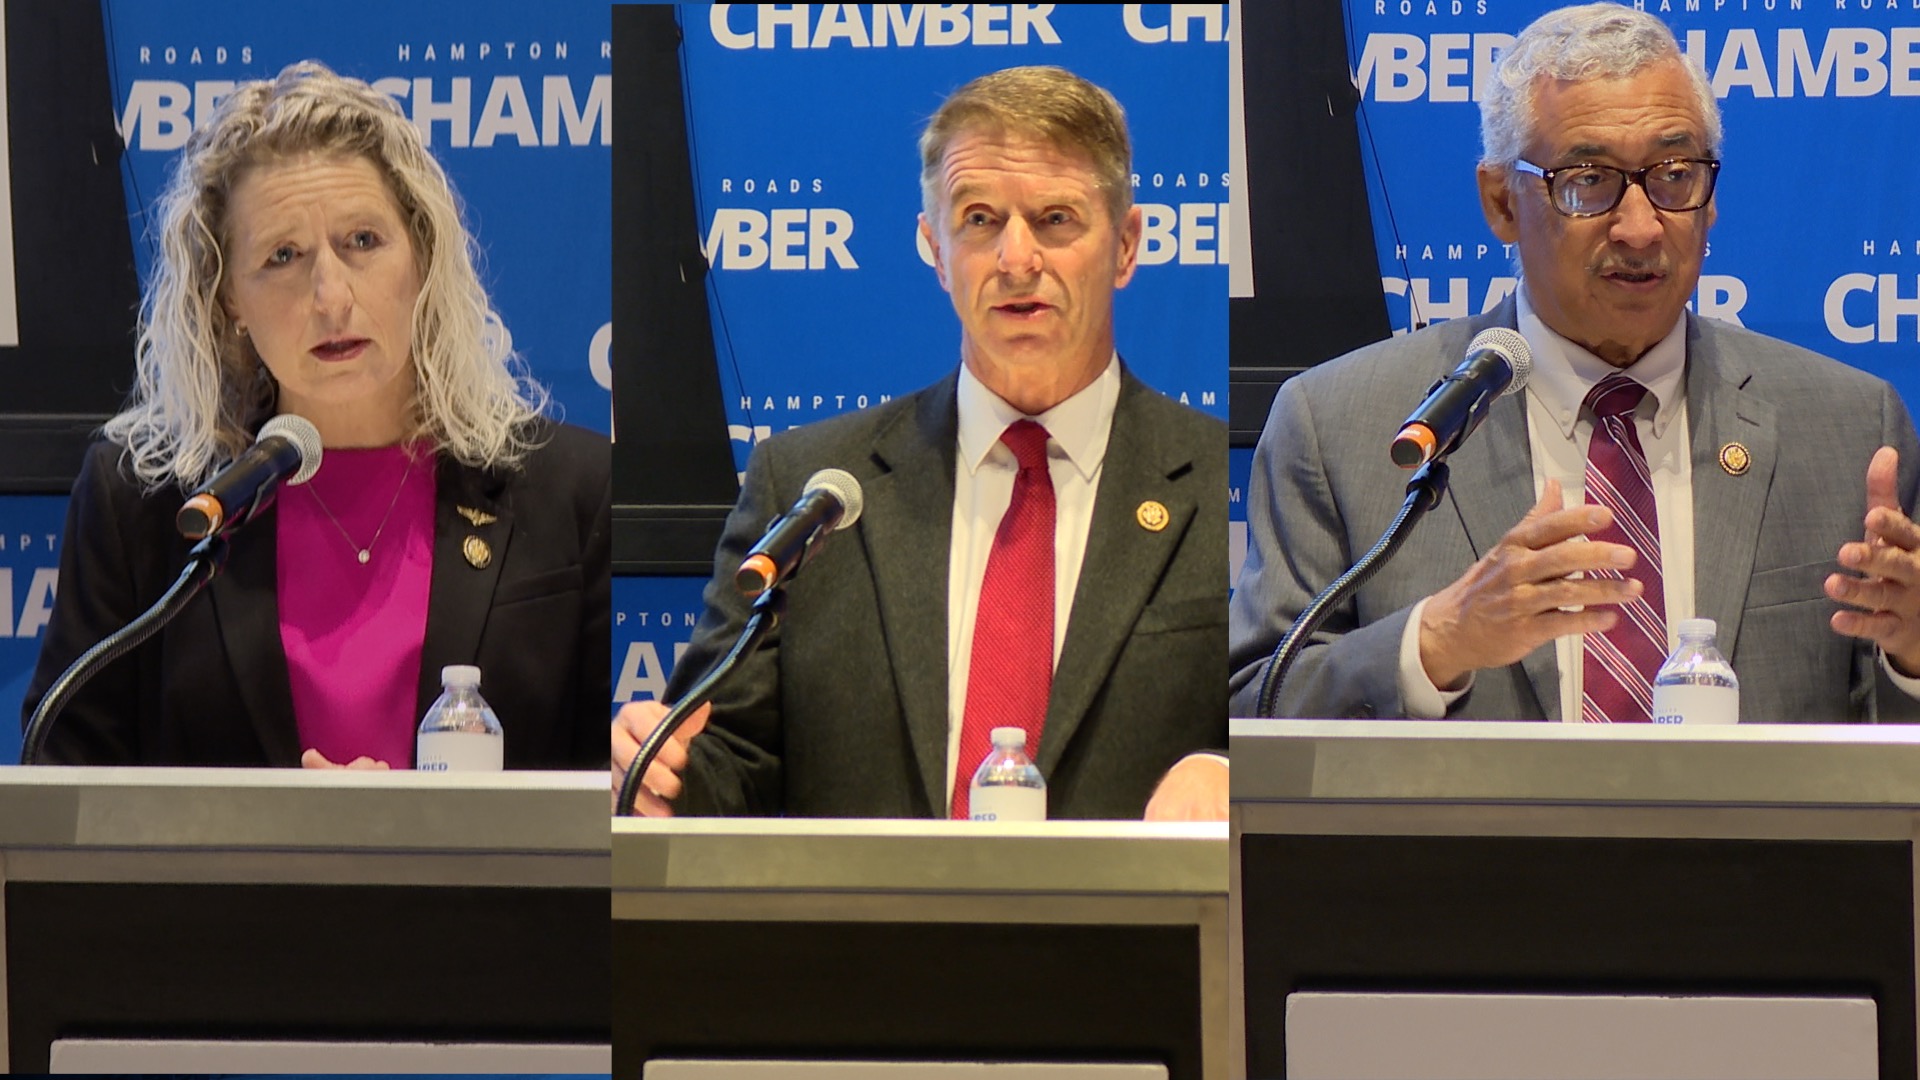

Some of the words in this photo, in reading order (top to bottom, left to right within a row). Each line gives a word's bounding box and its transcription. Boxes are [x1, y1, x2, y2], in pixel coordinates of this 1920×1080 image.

[1375, 0, 1488, 15] ROADS
[709, 4, 1062, 49] CHAMBER
[1123, 4, 1229, 43] CH
[140, 46, 252, 64] ROADS
[398, 42, 568, 61] HAMPTON
[722, 178, 823, 193] ROADS
[1131, 172, 1229, 188] ROADS
[1133, 203, 1229, 265] BE
[1395, 244, 1514, 260] HAMPT
[616, 612, 696, 627] PTON
